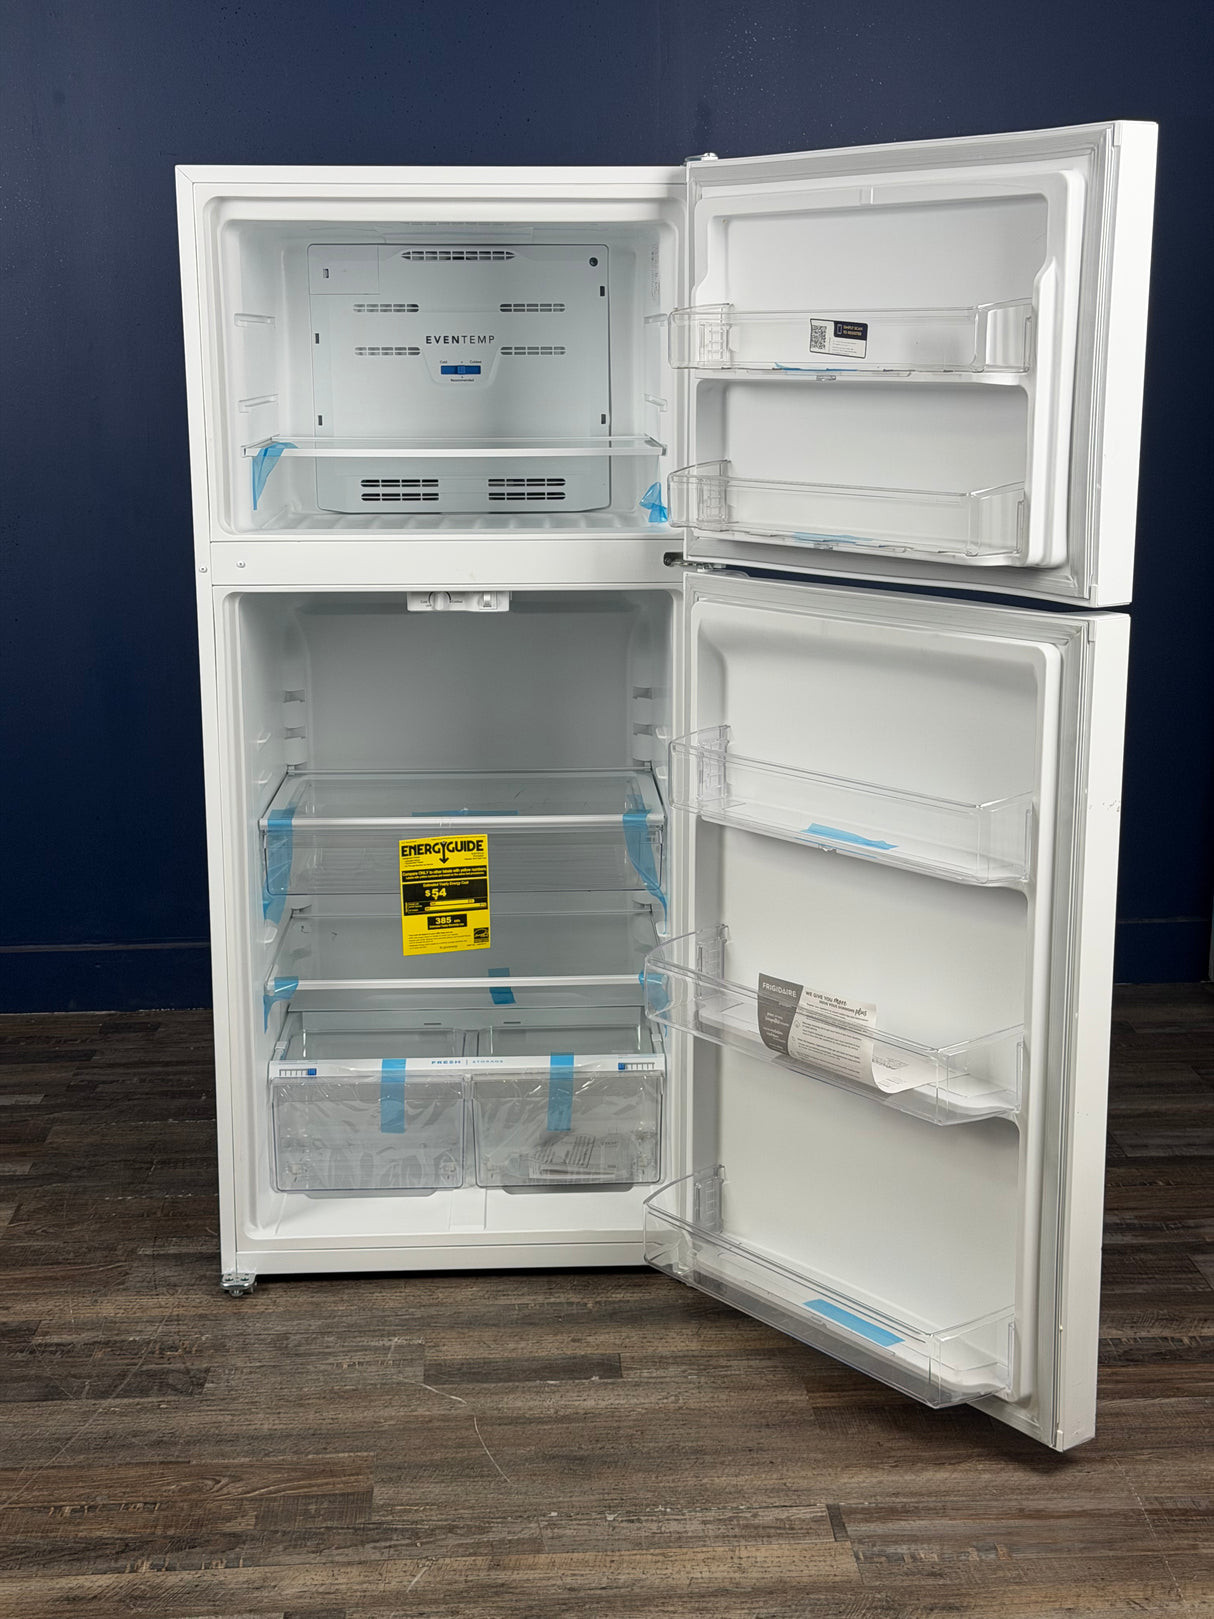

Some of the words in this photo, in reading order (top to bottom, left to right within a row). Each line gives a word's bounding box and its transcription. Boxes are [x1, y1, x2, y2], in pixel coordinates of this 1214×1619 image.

[425, 335, 495, 344] EVENTEMP
[401, 840, 484, 858] ENERGYGUIDE
[435, 916, 452, 925] 385
[762, 982, 797, 998] FRIGIDAIRE
